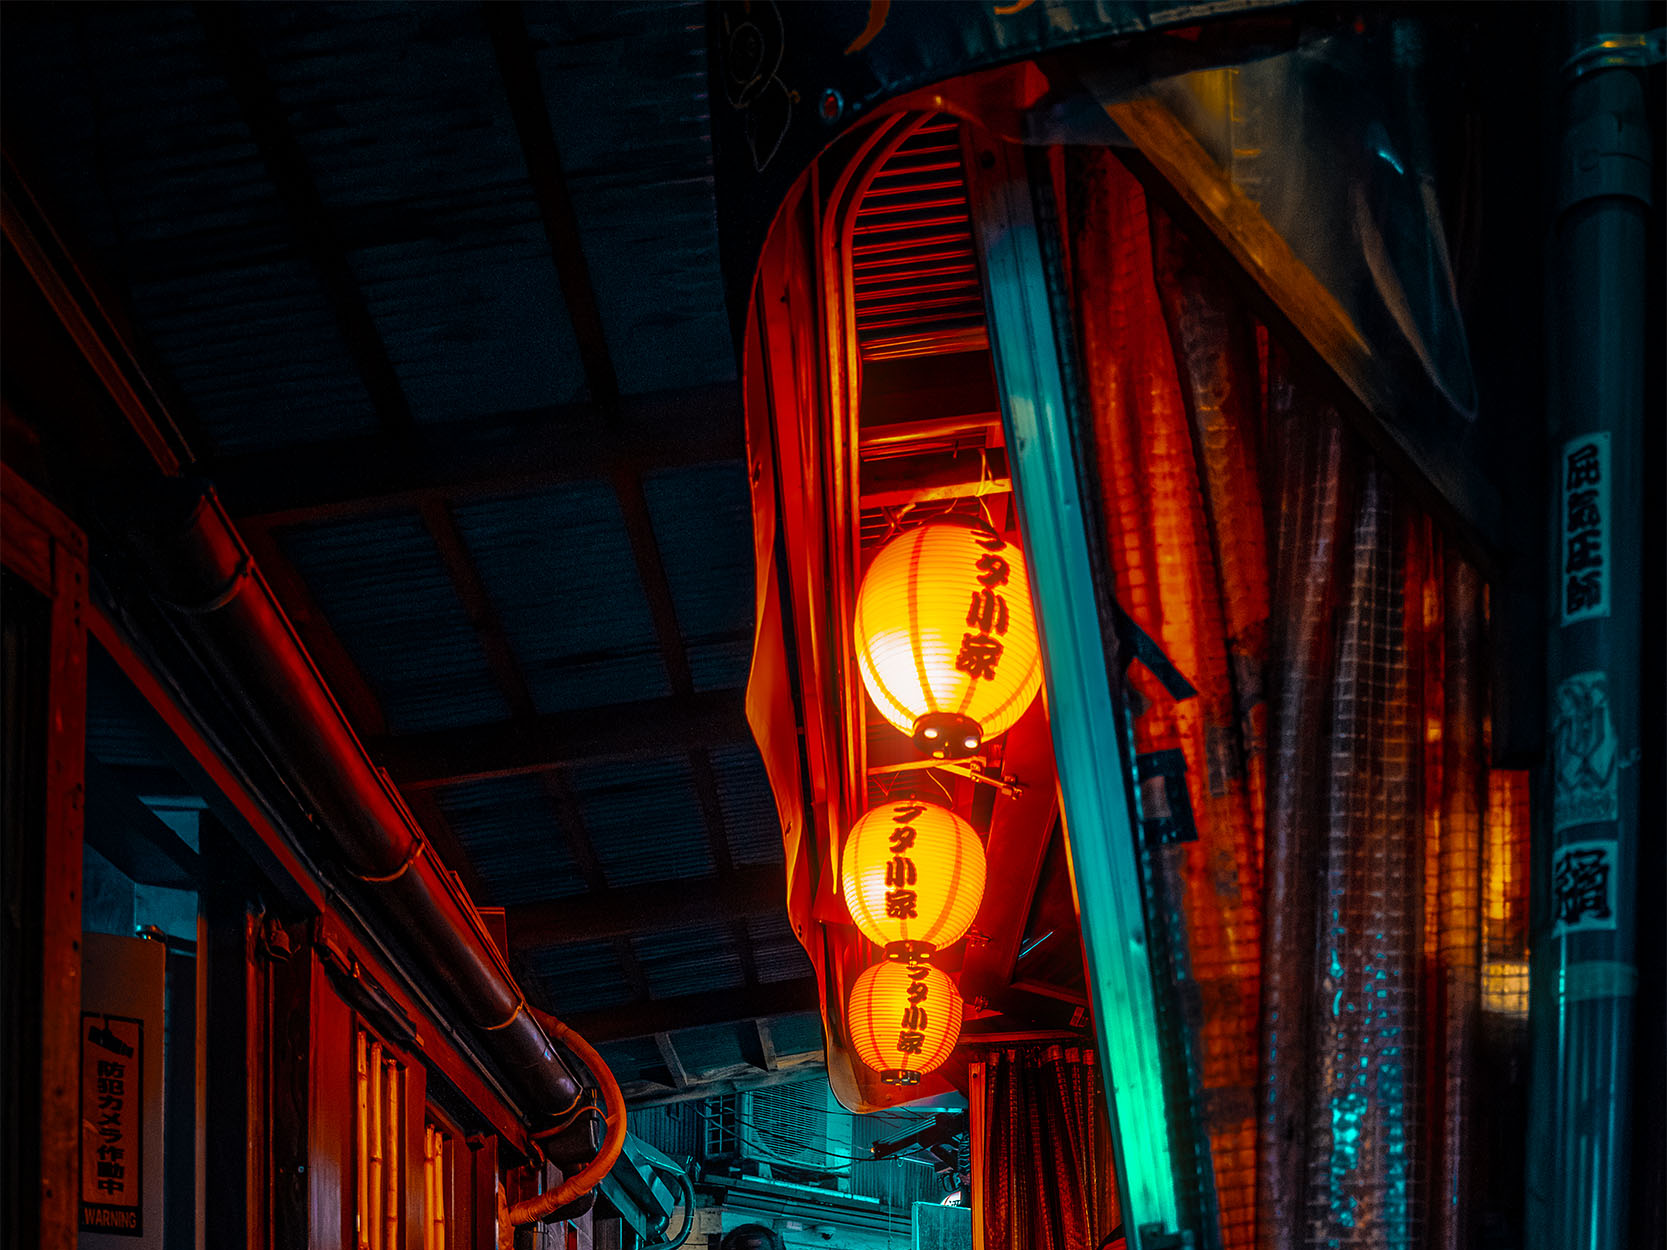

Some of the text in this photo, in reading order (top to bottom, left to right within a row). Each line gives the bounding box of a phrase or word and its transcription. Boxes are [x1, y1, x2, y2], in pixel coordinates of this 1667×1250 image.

[97, 1061, 125, 1195] 防犯カメラ作動中
[83, 1207, 137, 1230] WARNING
